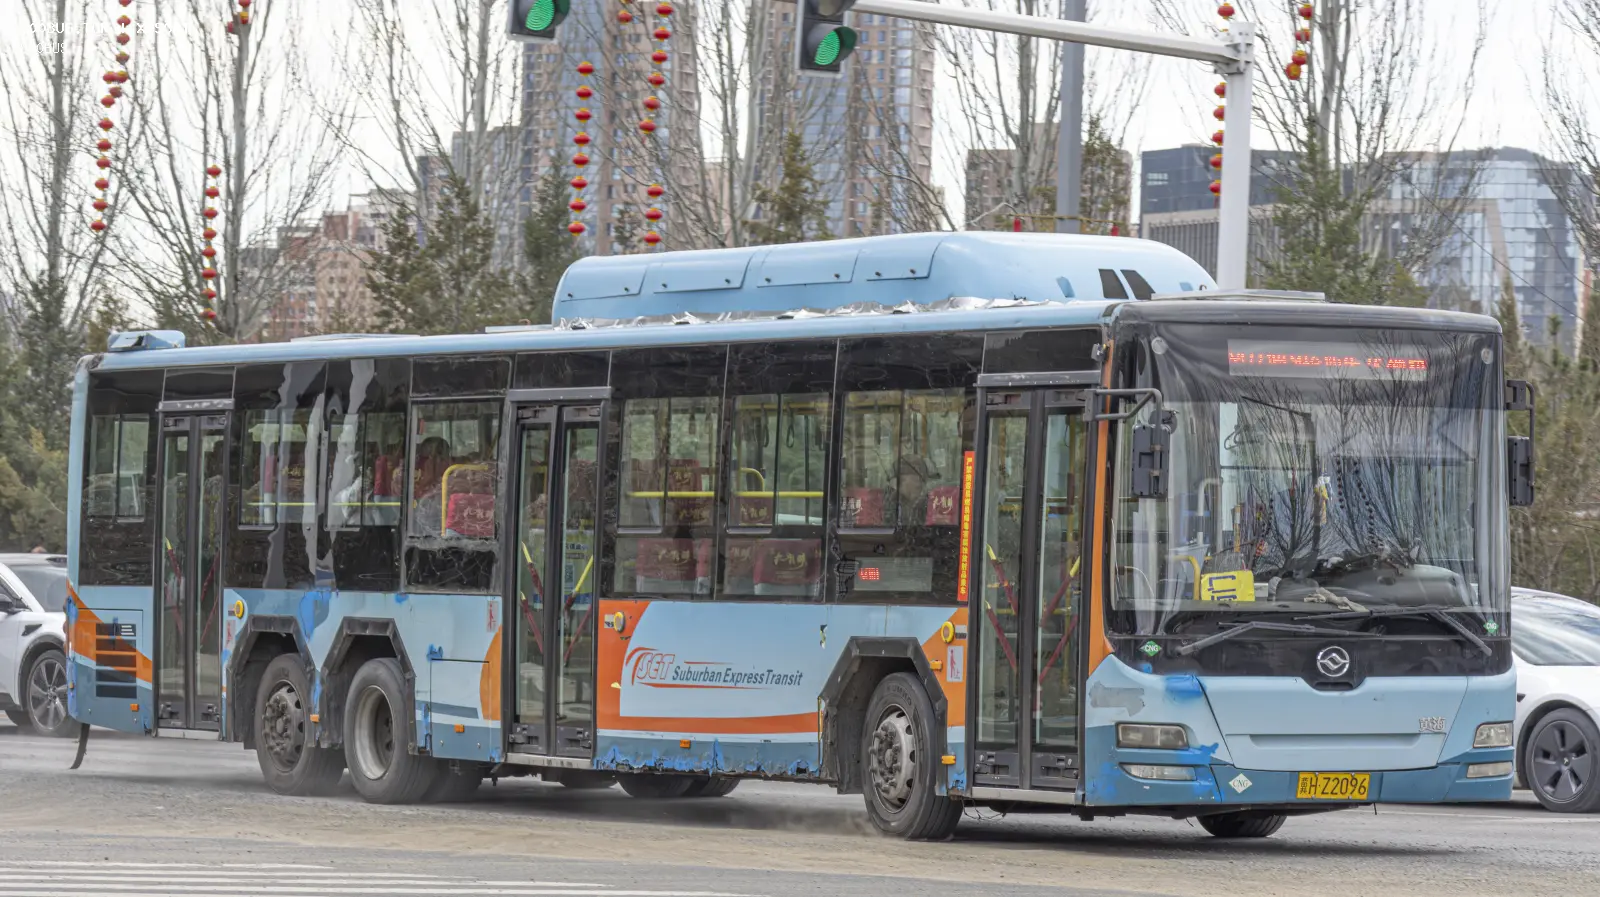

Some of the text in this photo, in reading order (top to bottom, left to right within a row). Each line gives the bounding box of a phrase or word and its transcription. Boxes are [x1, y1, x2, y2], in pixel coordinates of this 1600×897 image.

[1144, 644, 1159, 652] CNG
[672, 665, 722, 683] Suburban
[722, 667, 765, 687] Express
[764, 669, 803, 686] Transit
[1232, 779, 1250, 788] CNG
